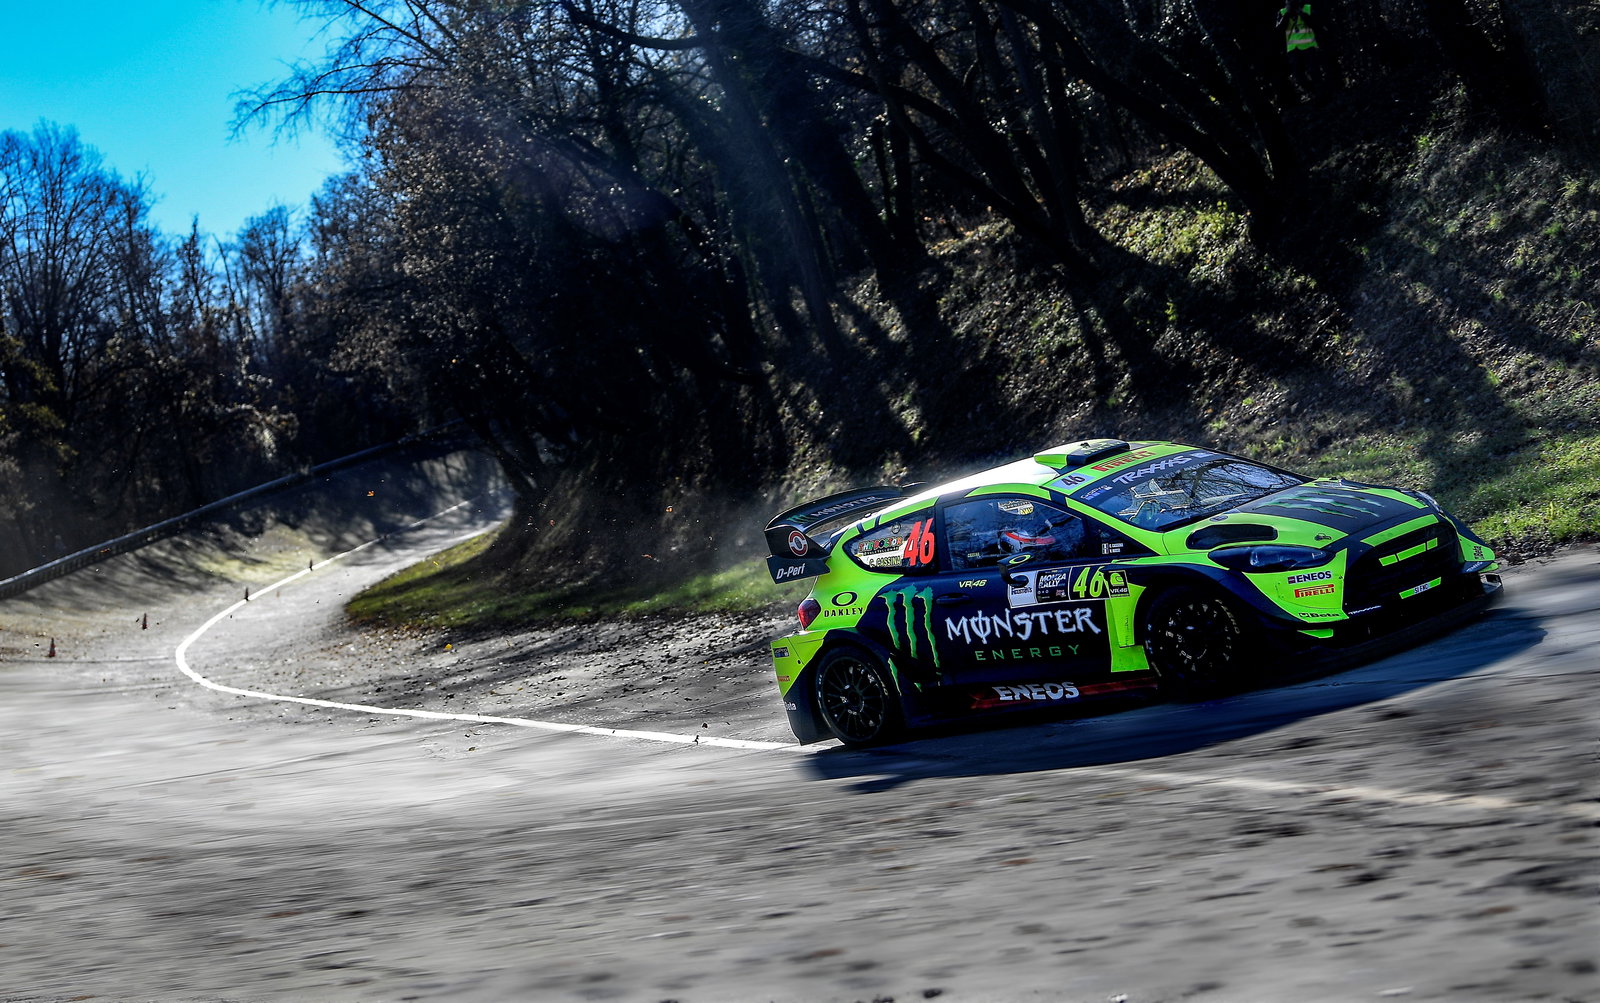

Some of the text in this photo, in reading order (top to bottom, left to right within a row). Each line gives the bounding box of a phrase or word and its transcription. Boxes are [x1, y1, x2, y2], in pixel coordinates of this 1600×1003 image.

[1091, 450, 1157, 472] PIRELLI
[1063, 475, 1086, 487] 46
[904, 518, 935, 566] 46
[776, 563, 806, 580] D-Perf
[1040, 573, 1067, 583] MONZA
[1296, 571, 1332, 583] ENEOS
[1038, 580, 1060, 589] RALLY
[1073, 566, 1105, 598] 46
[1294, 584, 1334, 598] PIRELLI
[824, 607, 865, 618] OAKLEY
[945, 608, 1101, 645] MONSTER
[975, 644, 1080, 661] ENERGY
[992, 681, 1080, 701] ENEOS
